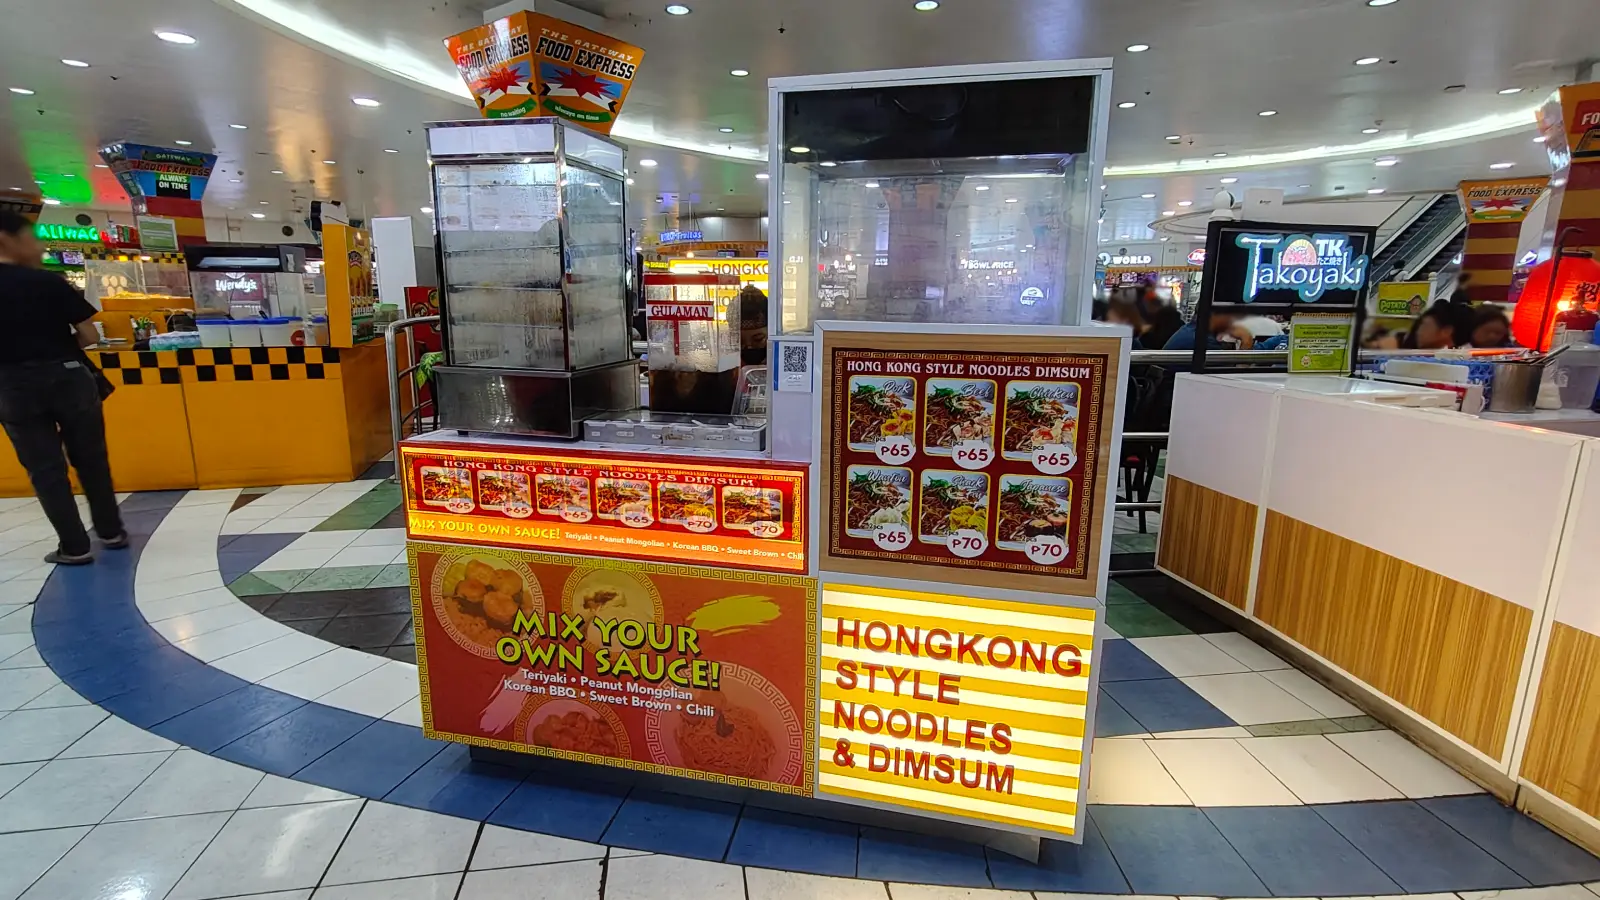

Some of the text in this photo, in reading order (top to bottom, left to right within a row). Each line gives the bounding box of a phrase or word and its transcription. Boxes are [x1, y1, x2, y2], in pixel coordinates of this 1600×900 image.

[456, 25, 522, 54] THE GATAY
[484, 33, 530, 65] EXESS
[541, 27, 634, 62] THE GATEWAY
[535, 36, 636, 80] FOOD EXPRESS
[159, 173, 188, 182] ALWAYS
[166, 164, 211, 176] EXPRESS
[171, 182, 188, 190] TIME
[1467, 190, 1493, 198] FOOD
[1494, 187, 1542, 197] EXPRESS
[38, 224, 98, 240] ALIWAG
[1112, 255, 1151, 265] WORLD
[1316, 239, 1344, 257] TK
[1240, 237, 1364, 297] Takoyaki
[215, 277, 258, 292] Wendy's
[651, 306, 709, 318] GULAMAN
[846, 360, 1090, 379] HONG KONG STYLE NOODLES DIMSUM
[883, 380, 911, 394] Pork
[961, 383, 992, 398] Beef
[1030, 385, 1075, 399] Chicken
[443, 460, 754, 486] HONG KONG STYLE NOODLES DIMSUM
[951, 474, 985, 488] Shark
[409, 517, 436, 530] MIX
[438, 520, 474, 532] YOUR
[478, 523, 510, 534] OWN
[514, 526, 560, 539] SAUCE!
[564, 532, 593, 541] Teriyaki
[599, 535, 625, 544] Peanut
[626, 538, 664, 547] Mongolian
[673, 542, 700, 551] Korean
[701, 544, 719, 553] BBQ
[727, 547, 751, 556] Sweet
[754, 549, 779, 558] Brown
[512, 608, 701, 655] MIX YOUR
[836, 616, 1083, 678] HONGKONG
[496, 637, 721, 690] OWN SAUCE!
[521, 668, 693, 700] Teriyaki Peanut Mongolian
[835, 659, 961, 706] STYLE
[504, 679, 715, 717] Korean BBQ Sweet Brown Chili
[833, 699, 1013, 755] NOODLES
[832, 737, 1016, 795] & DIMSUM
